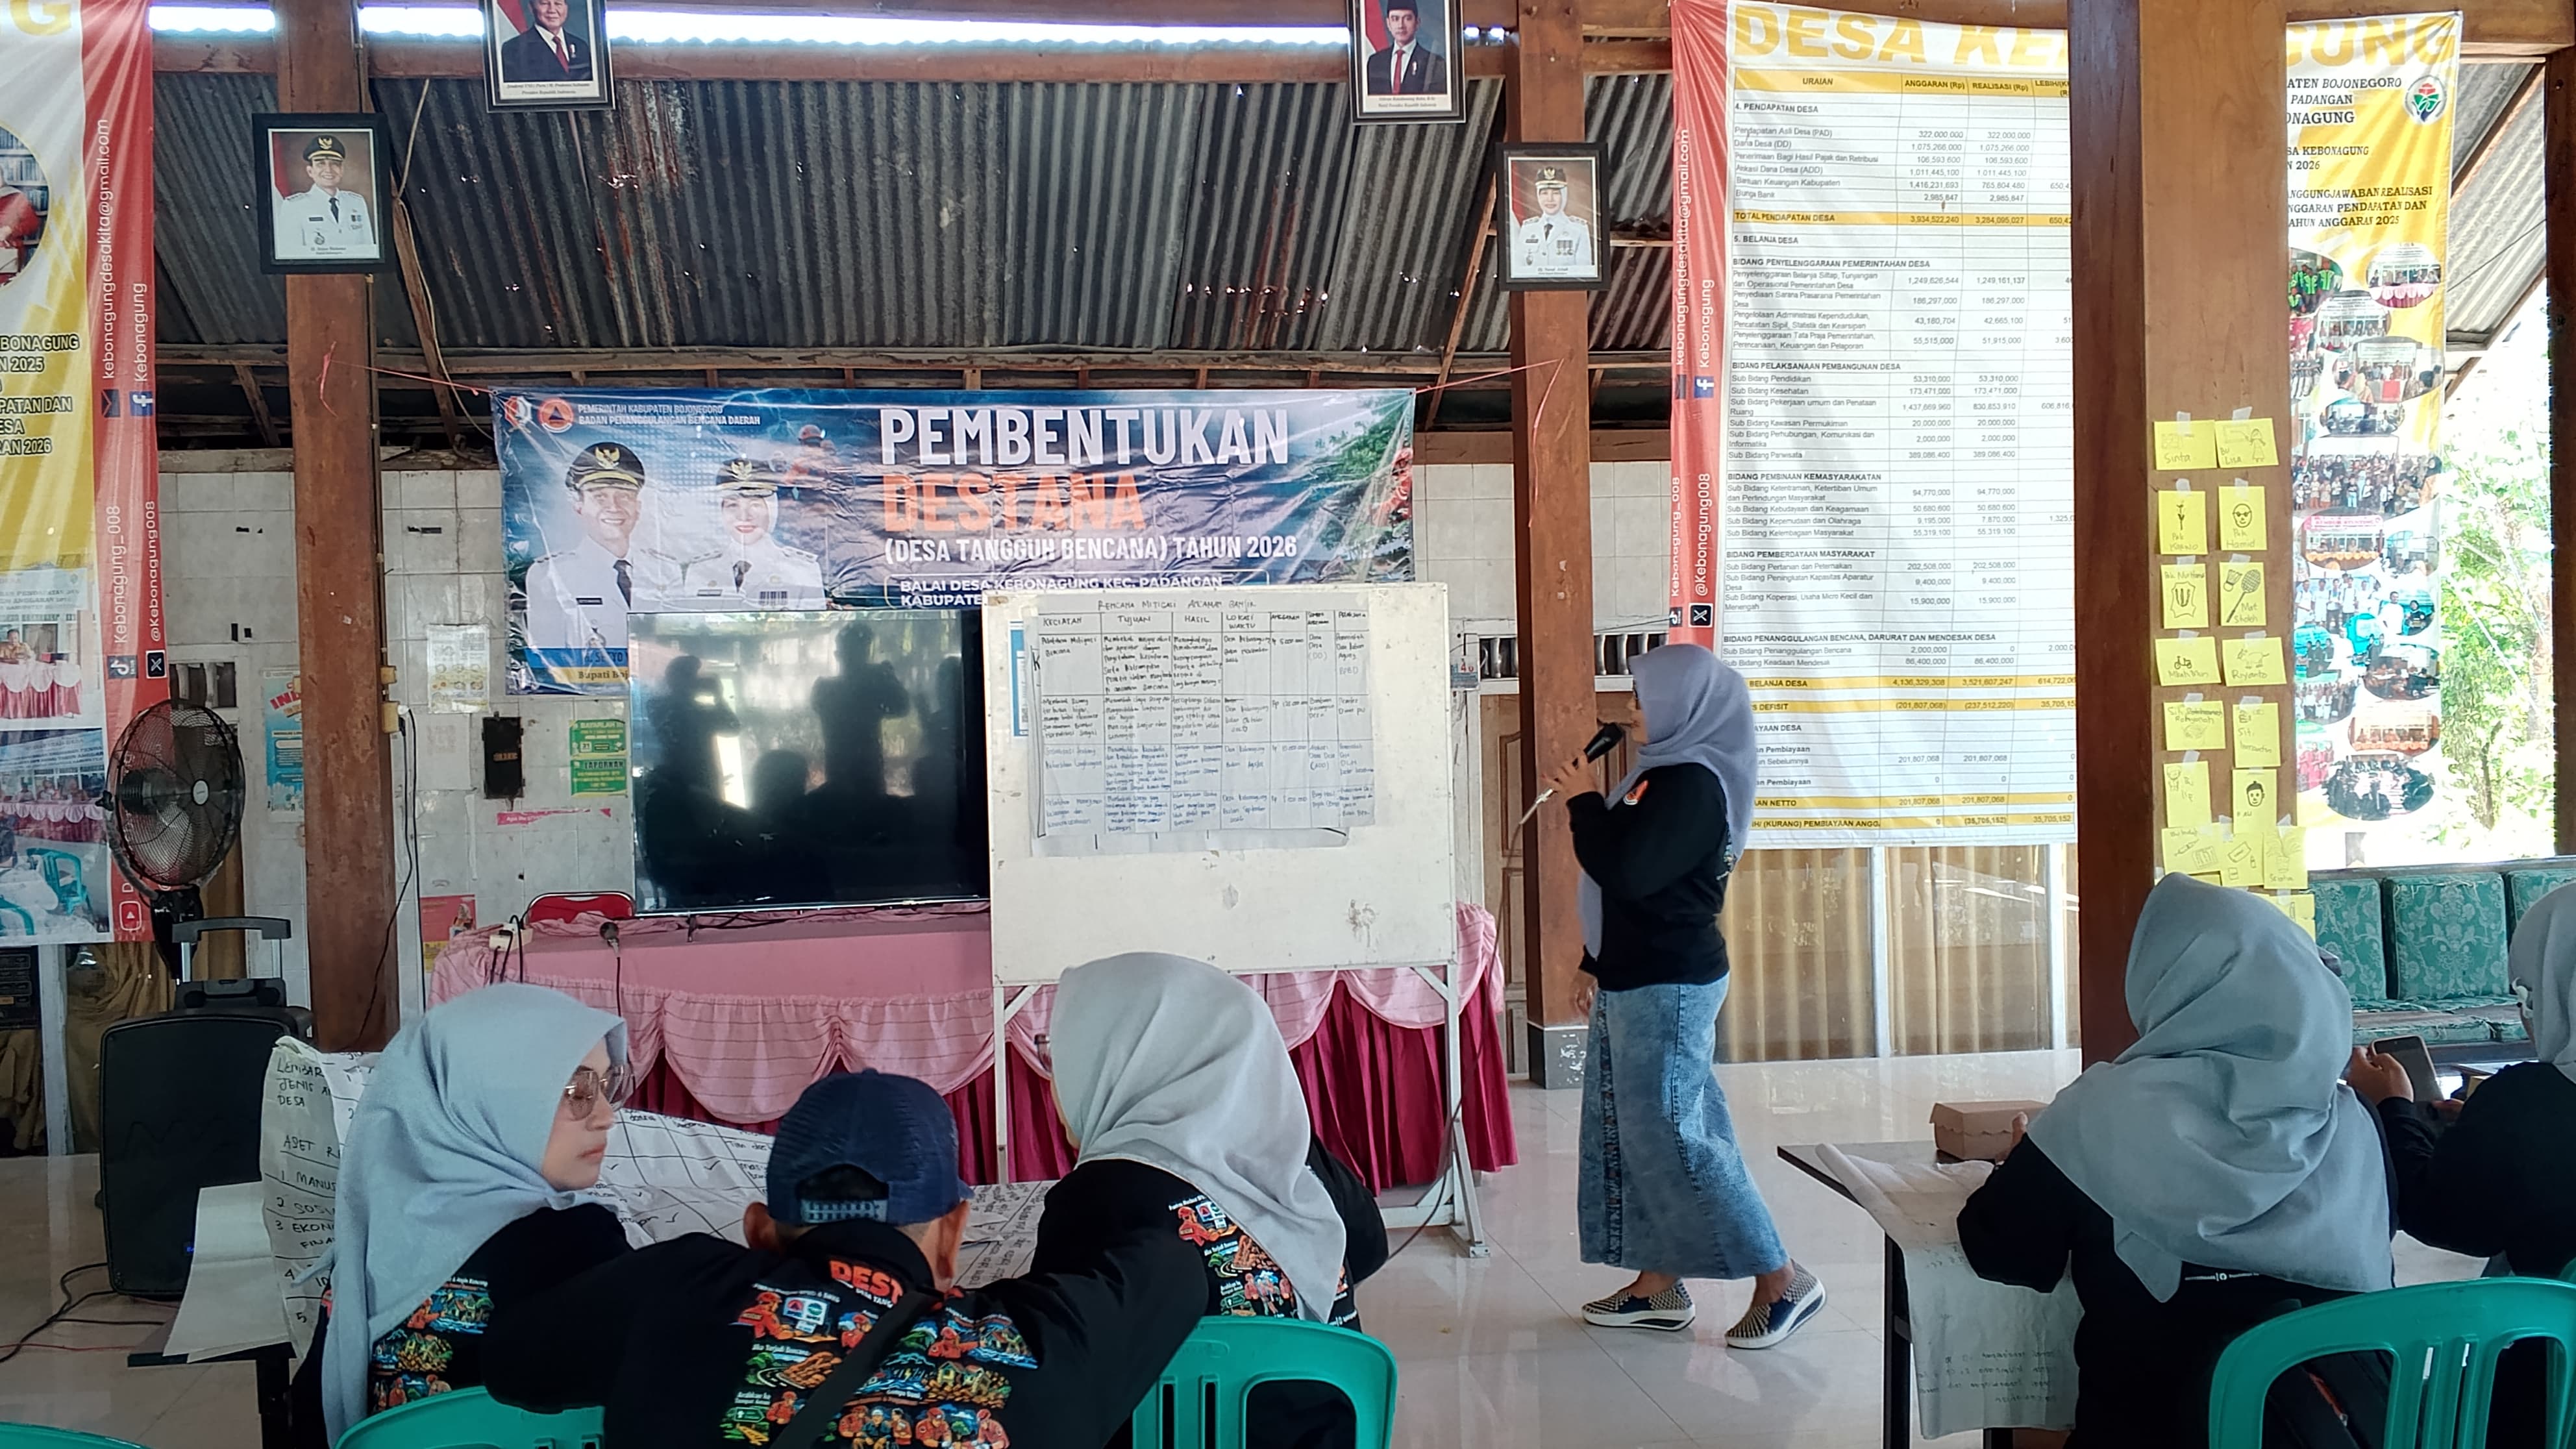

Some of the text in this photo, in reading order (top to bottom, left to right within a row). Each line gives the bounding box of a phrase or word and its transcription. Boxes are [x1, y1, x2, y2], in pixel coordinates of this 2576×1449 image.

[1734, 7, 2068, 67] DESA KE
[1950, 81, 1965, 90] (Rp)
[2322, 78, 2401, 88] BOJONEGORO
[2291, 95, 2352, 104] PADANGAN
[1744, 104, 1795, 112] PENDAPATAN
[1813, 129, 1832, 138] (PAD)
[1774, 141, 1791, 149] (DD)
[2303, 146, 2369, 156] KEBONAGUNG
[2296, 161, 2320, 169] 2026
[2381, 186, 2433, 196] REALISASI
[2337, 201, 2402, 212] PENDAPATAN
[2405, 201, 2427, 210] DAN
[2319, 217, 2373, 227] ANGGARAN
[2376, 216, 2399, 225] 2025
[97, 119, 116, 379] kebonagungdesakita@gmail.com
[1676, 130, 1691, 365] kebonagungdesakita@gmail.com
[1700, 279, 1715, 368] Kebonagung
[132, 283, 147, 382] Kebonagung
[0, 334, 79, 351] BONAGUNG
[10, 356, 44, 372] 2025
[43, 397, 73, 412] DAN
[578, 404, 723, 414] PEMERINTAH KABUPATEN BOJONEGORO
[578, 415, 761, 425] BADAN PENANGGULANGAN BENCANA DAERAH
[880, 407, 1289, 466] PEMBENTUKAN
[24, 438, 52, 454] 2026
[884, 472, 1145, 533] DESTANA
[1672, 477, 1681, 597] Kebonagung_008
[1695, 473, 1712, 596] @Kebonagung008
[885, 536, 1297, 564] (DESA TANGGUH BENCANA) TAHUN 2026
[106, 505, 130, 643] Kebonagung_008
[145, 501, 161, 641] @Kebonagung008
[900, 576, 1223, 592] BALAI DESA KEBONAGUNG KEC. PADANGAN
[900, 594, 982, 608] KABUPATE
[578, 671, 610, 680] Bupati
[278, 1095, 305, 1106] DESA
[284, 1135, 316, 1151] ASET
[275, 1220, 283, 1230] 3
[284, 1269, 295, 1280] 4
[296, 1312, 306, 1324] 5
